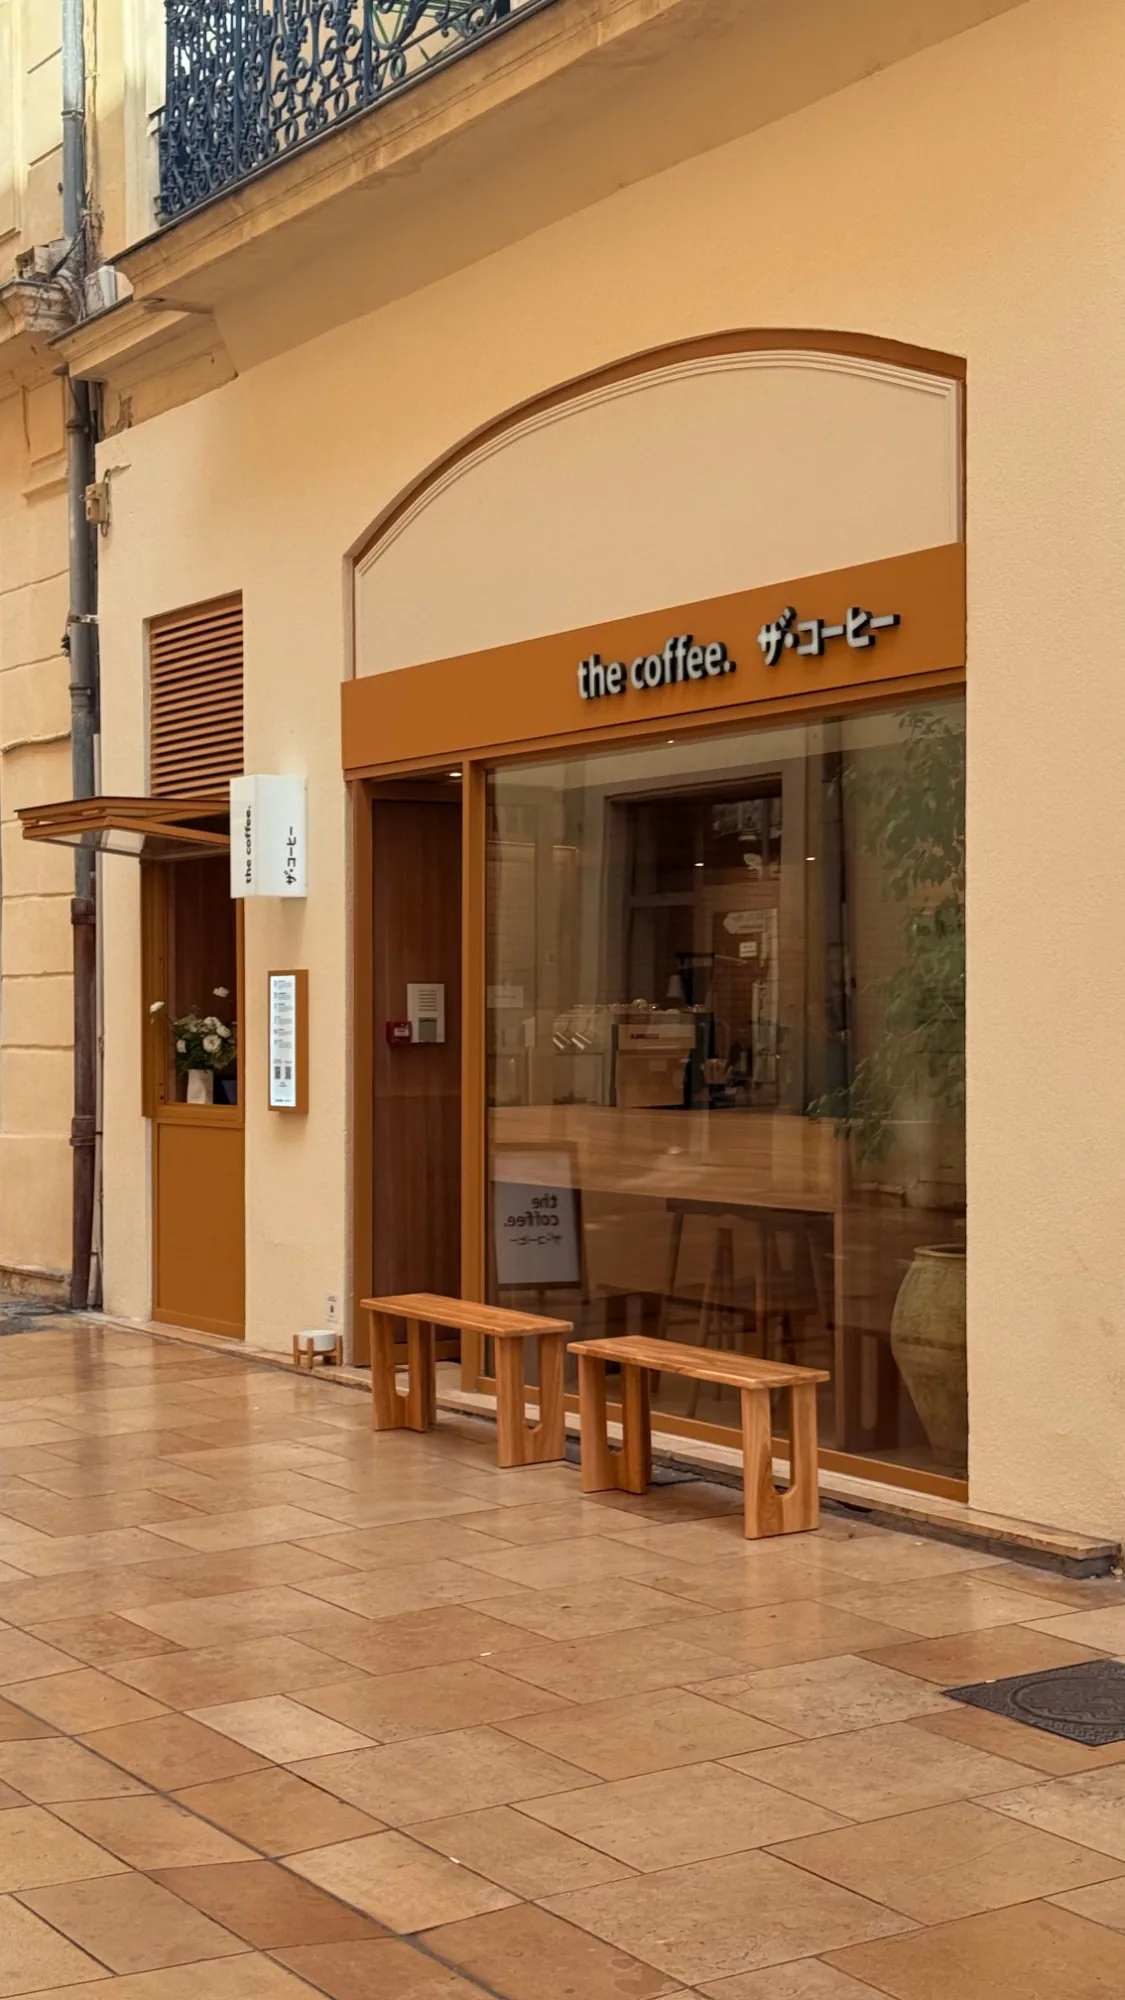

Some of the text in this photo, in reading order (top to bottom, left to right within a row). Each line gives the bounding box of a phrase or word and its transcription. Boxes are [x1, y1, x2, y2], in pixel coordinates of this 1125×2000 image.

[577, 633, 736, 700] the coffee.
[756, 606, 901, 667] ザ・コーヒー
[244, 805, 252, 855] coffee.
